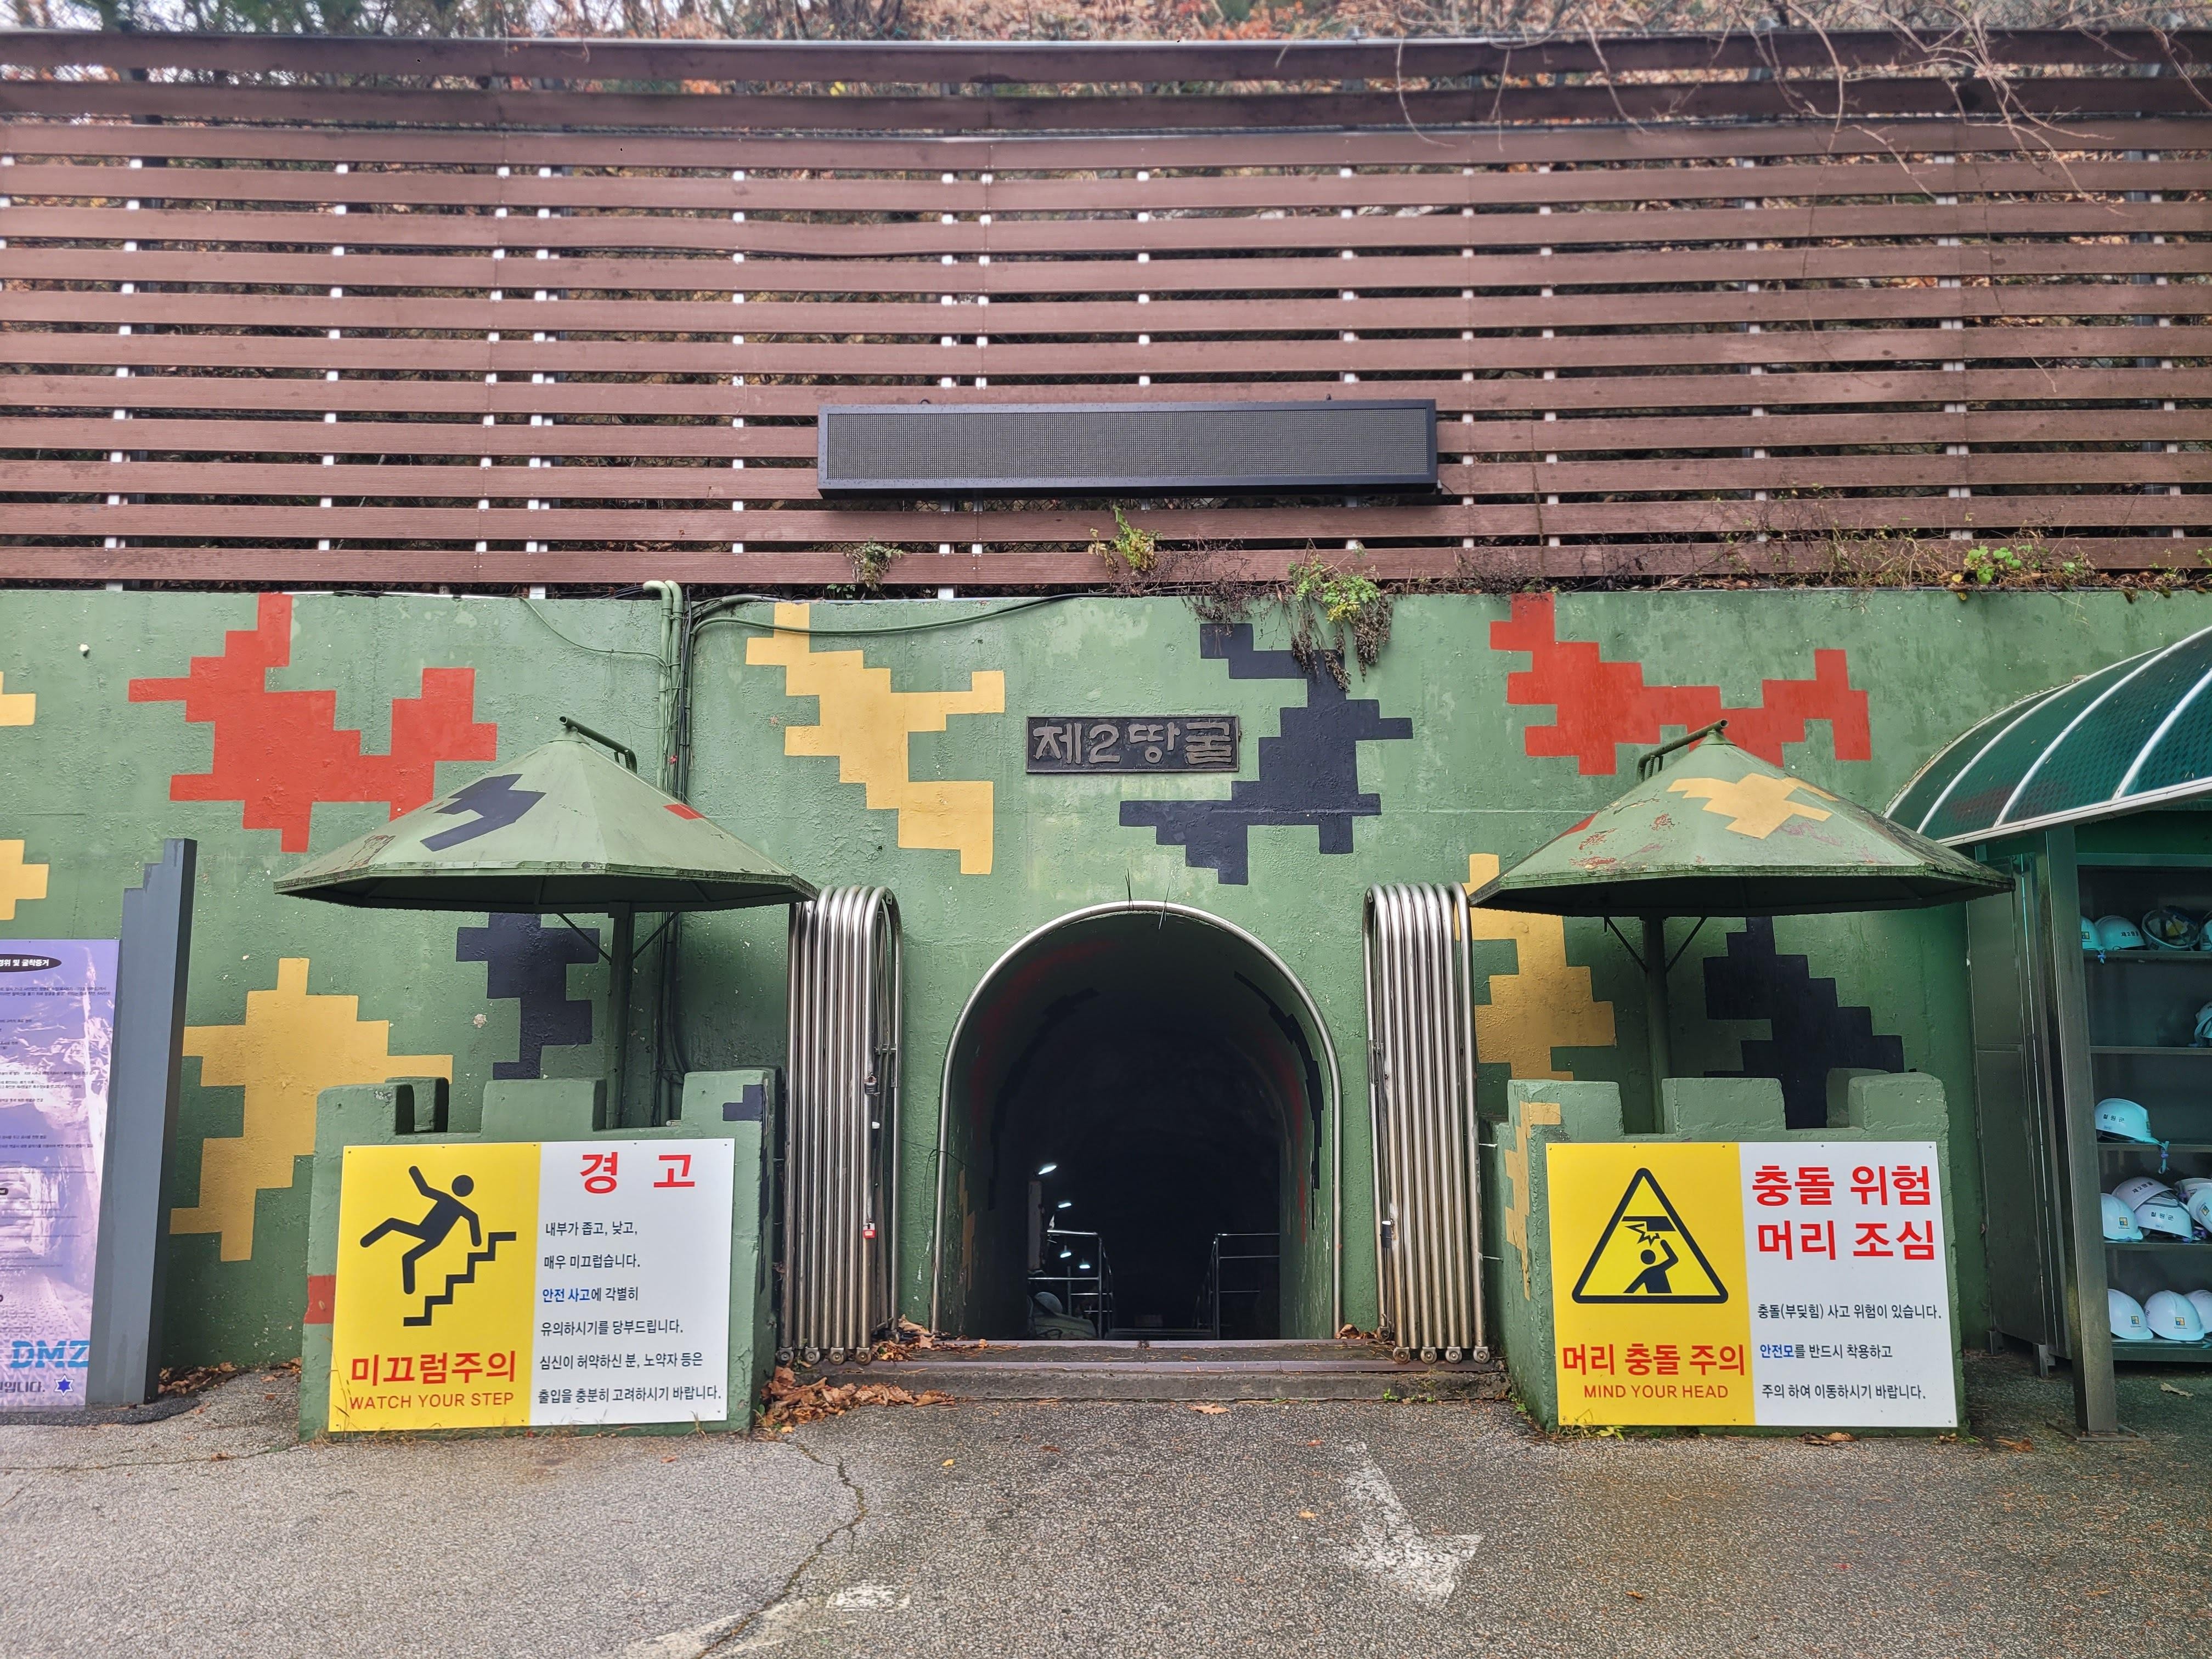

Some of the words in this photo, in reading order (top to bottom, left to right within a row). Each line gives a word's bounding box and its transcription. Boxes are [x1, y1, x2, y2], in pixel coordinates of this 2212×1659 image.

[1033, 721, 1232, 764] 제2땅굴
[1752, 1166, 1835, 1206] 충돌
[1850, 1166, 1930, 1205] 위험
[546, 1222, 579, 1236] 내부가
[582, 1222, 607, 1236] 좁고,
[613, 1221, 637, 1235] 낮고,
[1758, 1221, 1836, 1260] 머리
[1853, 1221, 1934, 1260] 조심
[544, 1255, 566, 1269] 매우
[570, 1254, 640, 1268] 미끄럽습니다.
[543, 1289, 565, 1302] 안전
[568, 1288, 601, 1302] 사고에
[606, 1286, 638, 1301] 각별히
[1827, 1305, 1850, 1318] 사고
[1854, 1304, 1887, 1318] 위험이
[1892, 1305, 1941, 1319] 있습니다.
[541, 1321, 609, 1336] 유의하시기를
[613, 1319, 682, 1334] 당부드립니다.
[10, 1340, 90, 1368] DMZ
[1563, 1344, 1615, 1375] 머리
[1625, 1344, 1680, 1375] 충돌
[1689, 1345, 1744, 1375] 주의
[1760, 1344, 1805, 1358] 안전모를
[1809, 1344, 1842, 1358] 반드시
[1847, 1344, 1893, 1359] 착용하고
[352, 1351, 515, 1386] 미끄럼주의
[540, 1355, 573, 1370] 심신이
[577, 1354, 622, 1369] 허약하신
[625, 1353, 639, 1368] 분,
[644, 1353, 678, 1367] 노약자
[680, 1352, 703, 1367] 등은
[0, 1381, 45, 1393] 입니다.
[538, 1389, 572, 1403] 출입을
[575, 1388, 609, 1403] 충분히
[612, 1387, 668, 1402] 고려하시기
[673, 1385, 721, 1400] 바랍니다.
[1584, 1385, 1626, 1398] MIND
[1631, 1385, 1677, 1398] YOUR
[1683, 1385, 1728, 1398] HEAD
[1762, 1384, 1784, 1398] 주의
[1788, 1384, 1810, 1398] 하여
[1815, 1384, 1871, 1399] 이동하시기
[1876, 1385, 1925, 1399] 바랍니다.
[349, 1395, 411, 1409] WATCH
[418, 1393, 465, 1407] YOUR
[471, 1392, 514, 1406] STEP
